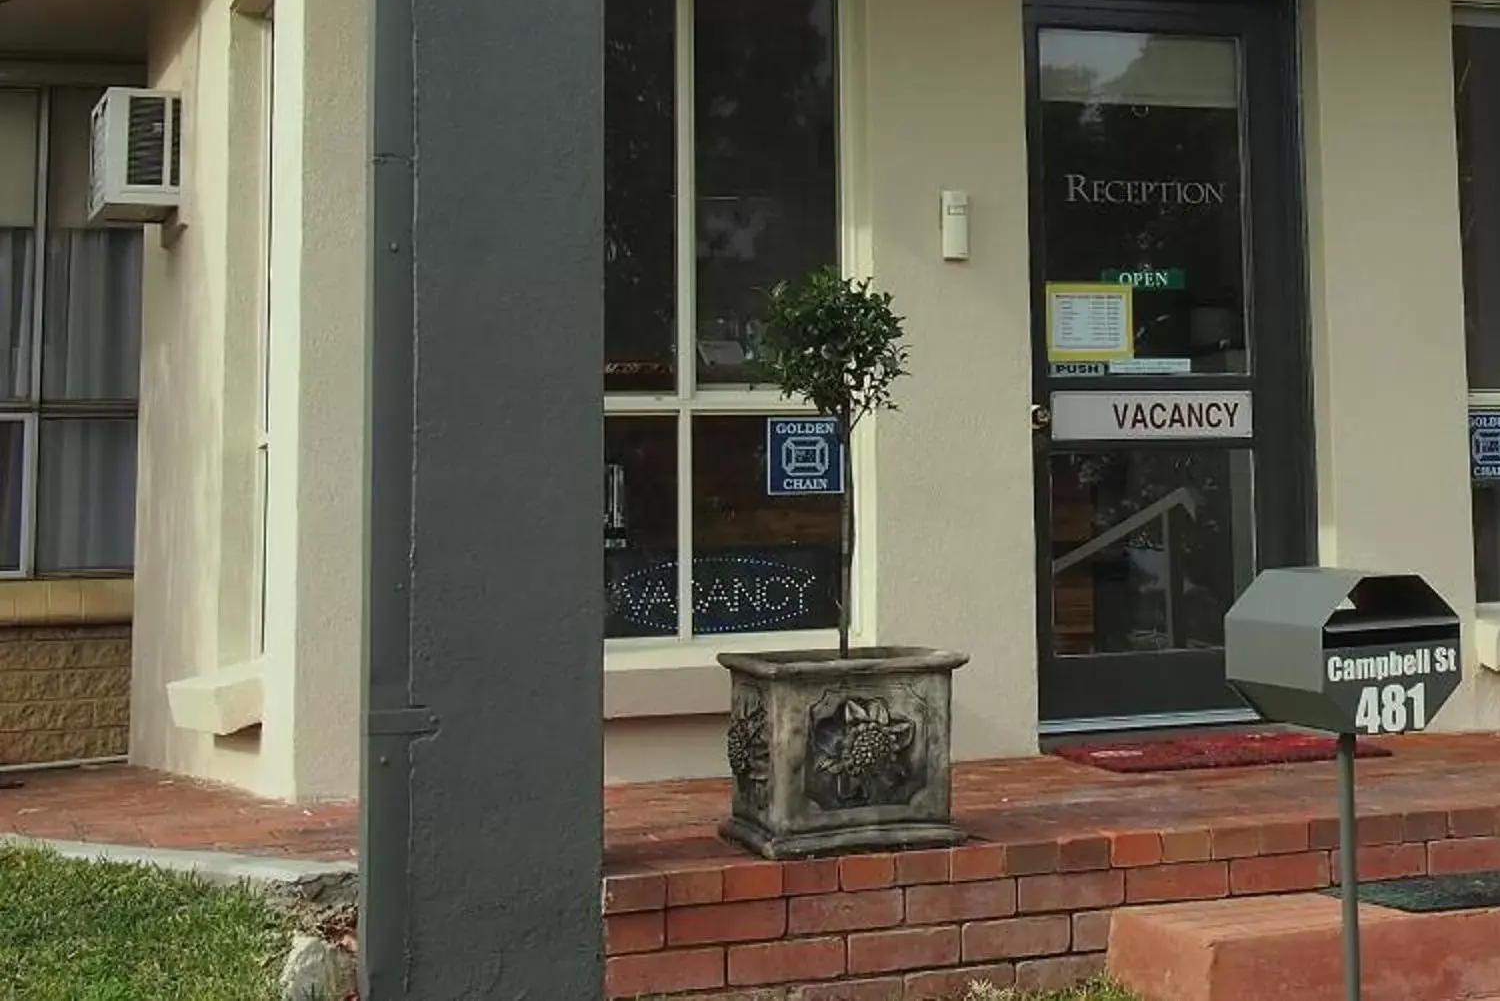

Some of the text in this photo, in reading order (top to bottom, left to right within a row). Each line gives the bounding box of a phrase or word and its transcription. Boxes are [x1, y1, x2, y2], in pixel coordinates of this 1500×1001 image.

[1119, 271, 1168, 287] OPEN
[1055, 364, 1099, 374] PUSH
[1113, 402, 1240, 429] VACANCY
[776, 422, 834, 434] GOLDEN
[783, 478, 828, 490] CHAIN
[1327, 646, 1457, 682] Campbell St
[1355, 682, 1425, 734] 481
